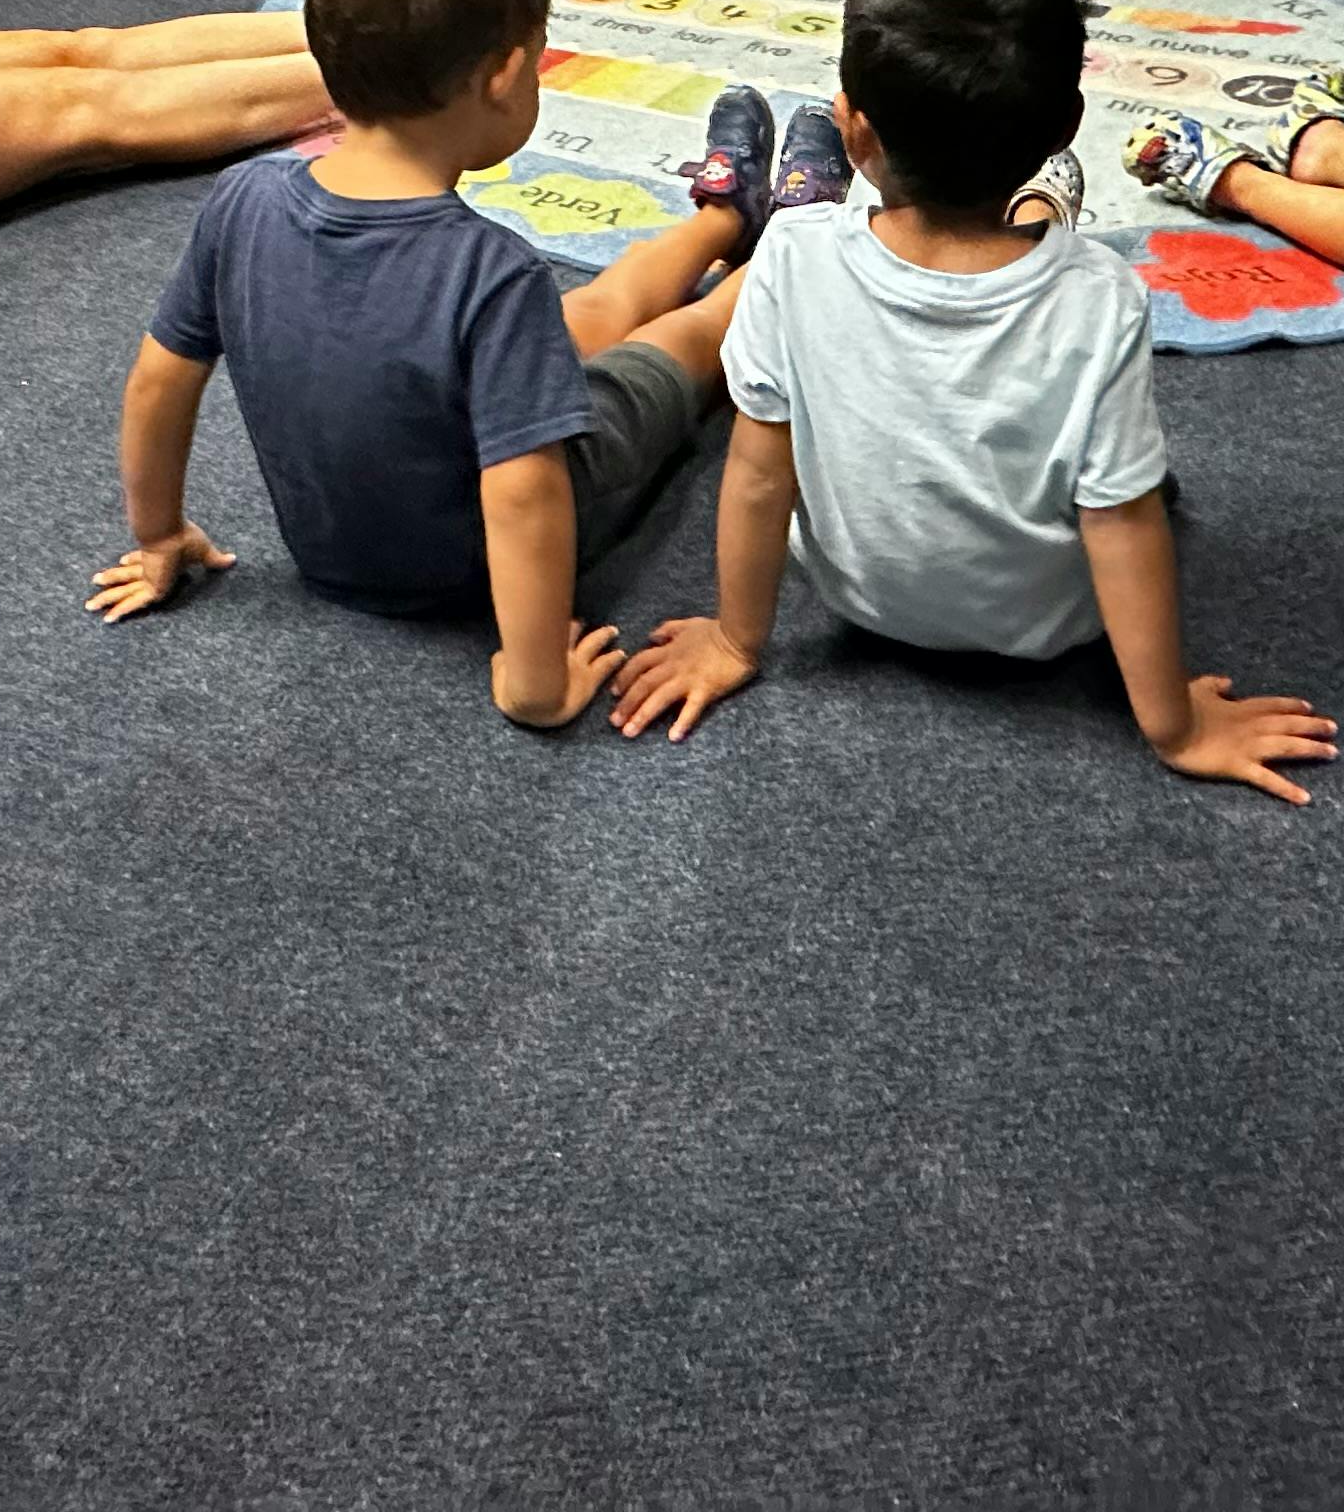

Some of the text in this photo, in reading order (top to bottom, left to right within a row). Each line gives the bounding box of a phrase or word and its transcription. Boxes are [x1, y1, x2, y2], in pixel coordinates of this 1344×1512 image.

[592, 17, 656, 35] three
[671, 29, 723, 45] four
[743, 40, 792, 57] five
[719, 4, 752, 20] 4
[791, 16, 836, 33] 5
[1145, 66, 1189, 86] 9
[1147, 37, 1250, 59] nueve
[519, 186, 623, 225] Verde
